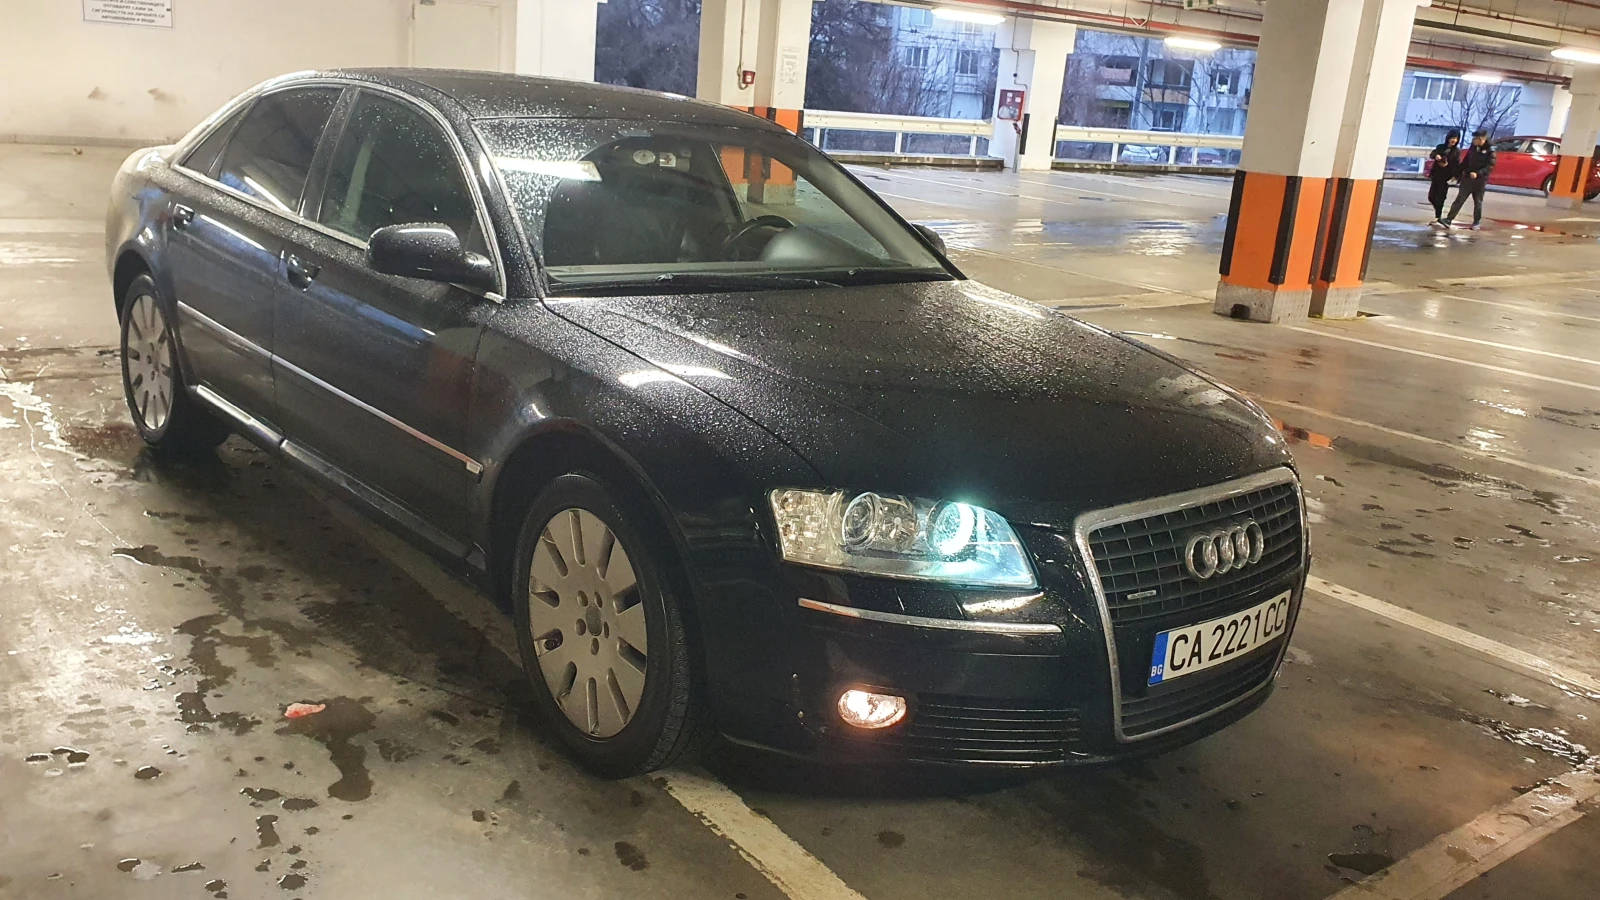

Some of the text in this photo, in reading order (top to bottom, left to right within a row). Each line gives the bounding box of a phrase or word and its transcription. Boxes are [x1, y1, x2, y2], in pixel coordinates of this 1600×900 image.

[1170, 597, 1287, 671] CA 2221 CC
[1151, 664, 1163, 677] BG
